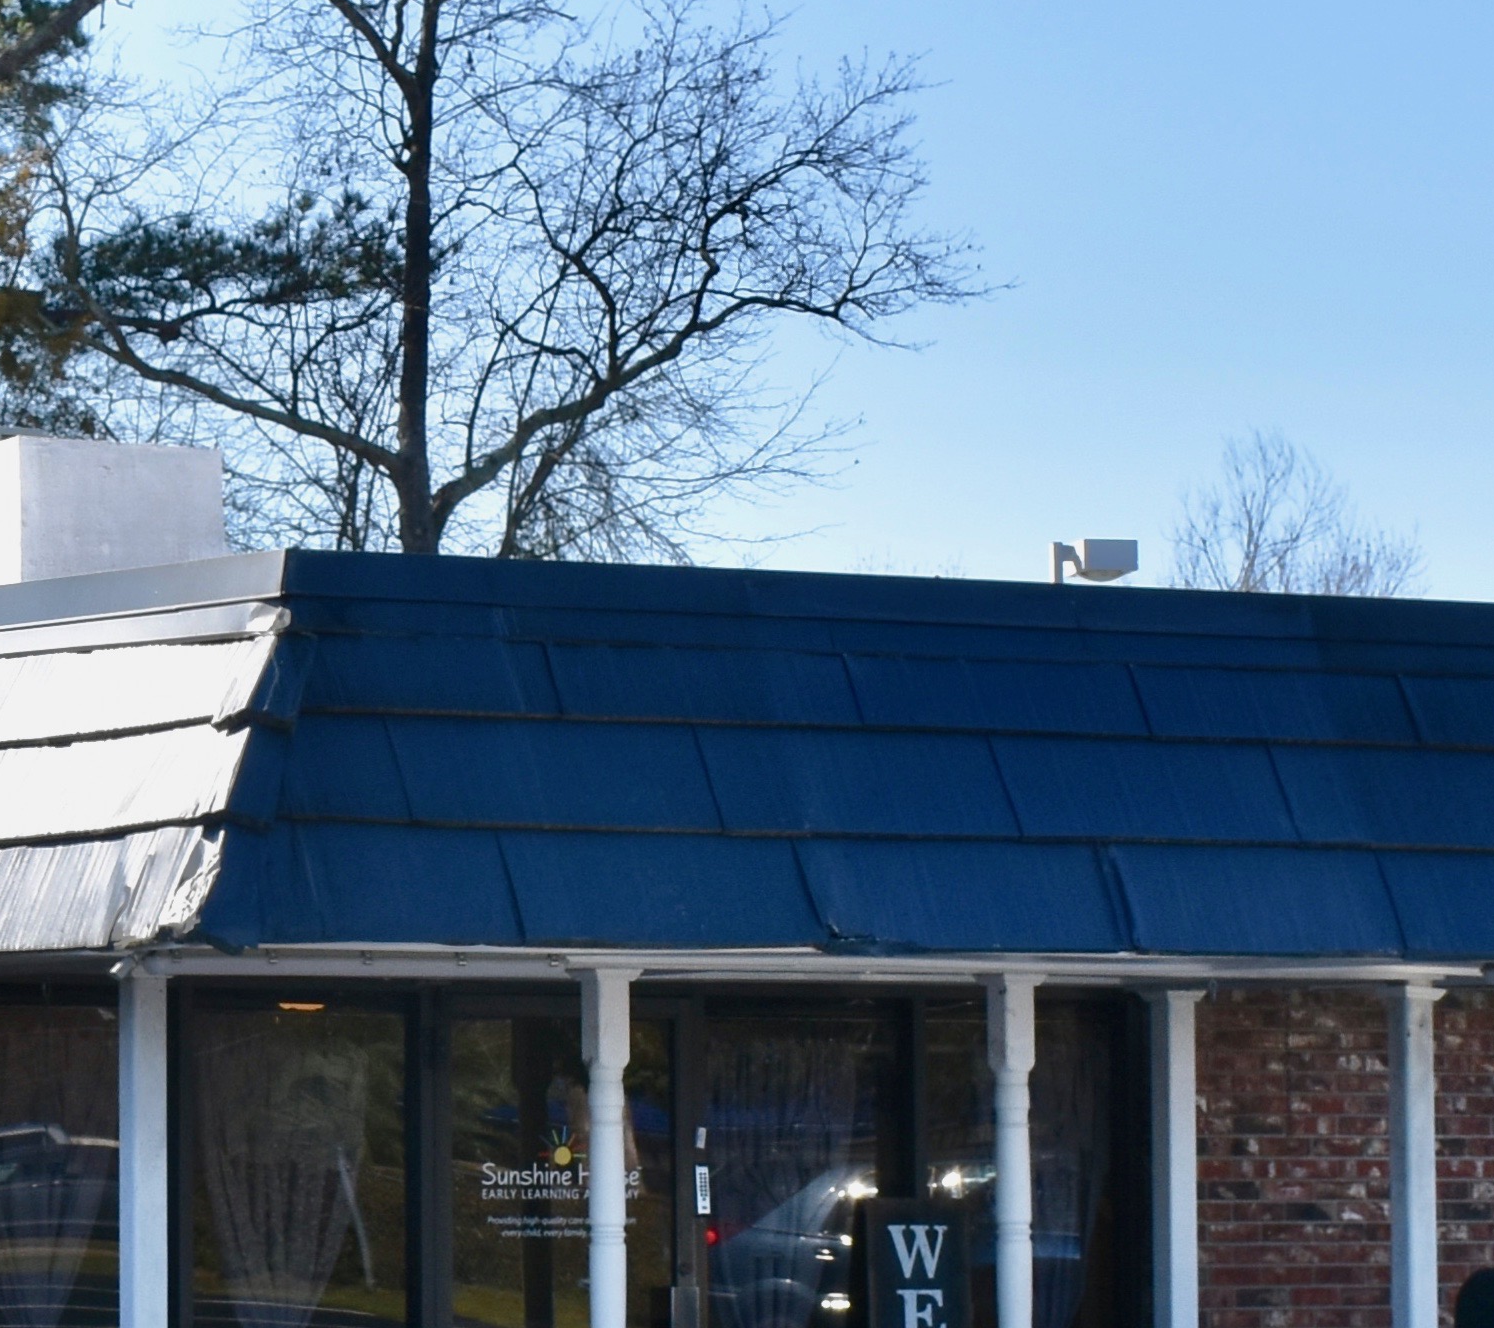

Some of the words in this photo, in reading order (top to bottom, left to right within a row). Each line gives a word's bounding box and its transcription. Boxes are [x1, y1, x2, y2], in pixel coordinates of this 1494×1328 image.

[481, 1162, 572, 1186] Sunshine
[481, 1189, 516, 1200] EARLY
[521, 1189, 579, 1200] LEARNING
